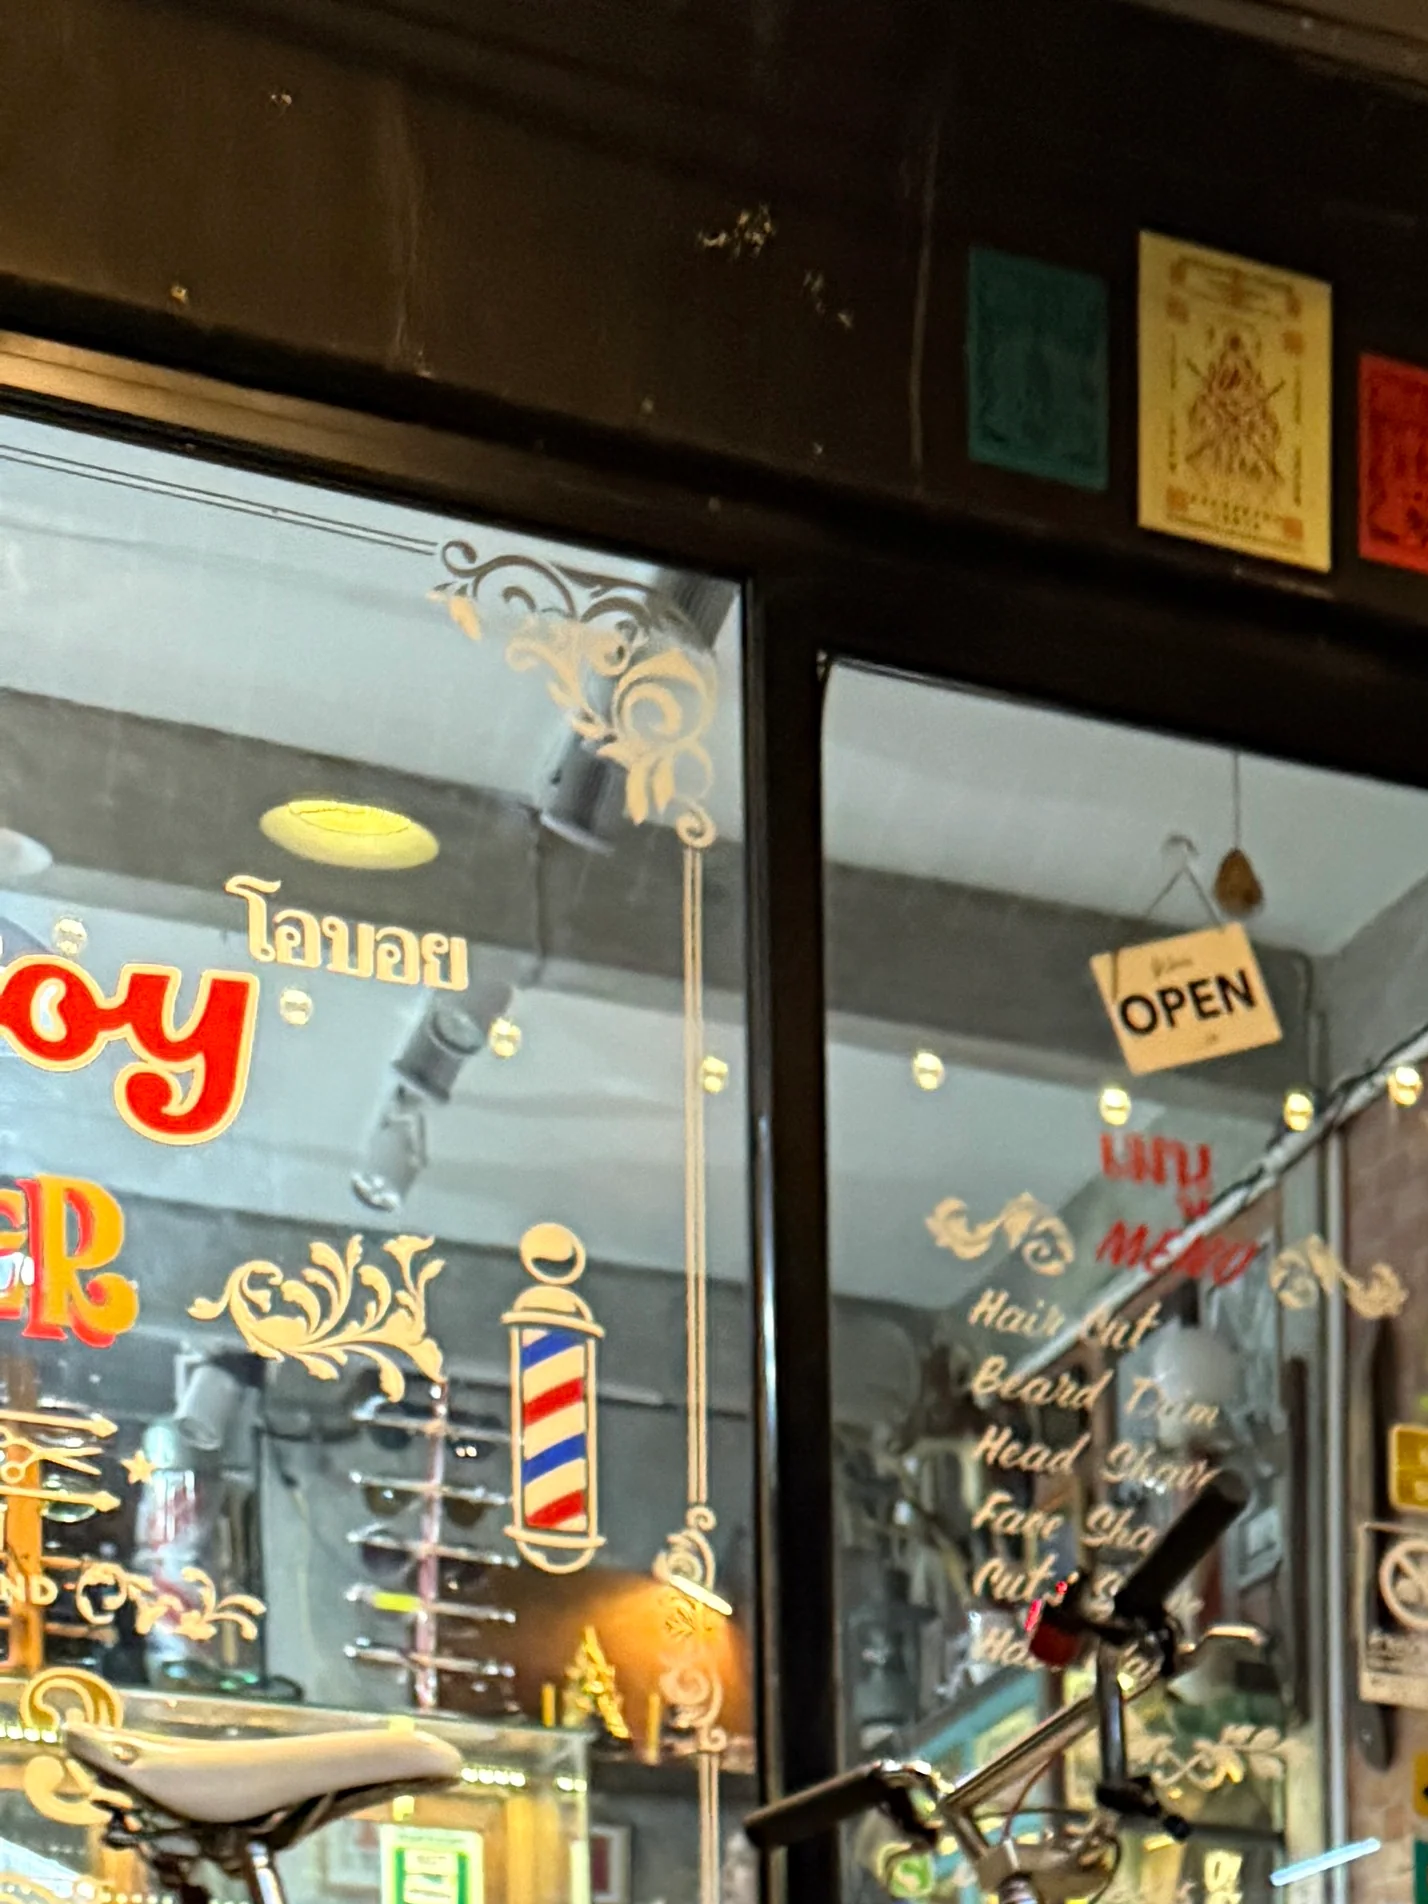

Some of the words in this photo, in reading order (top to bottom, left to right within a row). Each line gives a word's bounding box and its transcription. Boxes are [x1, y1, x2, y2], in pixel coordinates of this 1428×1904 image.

[225, 873, 470, 991] โอบอย
[1120, 968, 1258, 1036] OPEN
[967, 1287, 1066, 1338] Hair
[971, 1356, 1116, 1412] Beard
[967, 1425, 1092, 1475] Head
[1080, 1502, 1160, 1551] Sha
